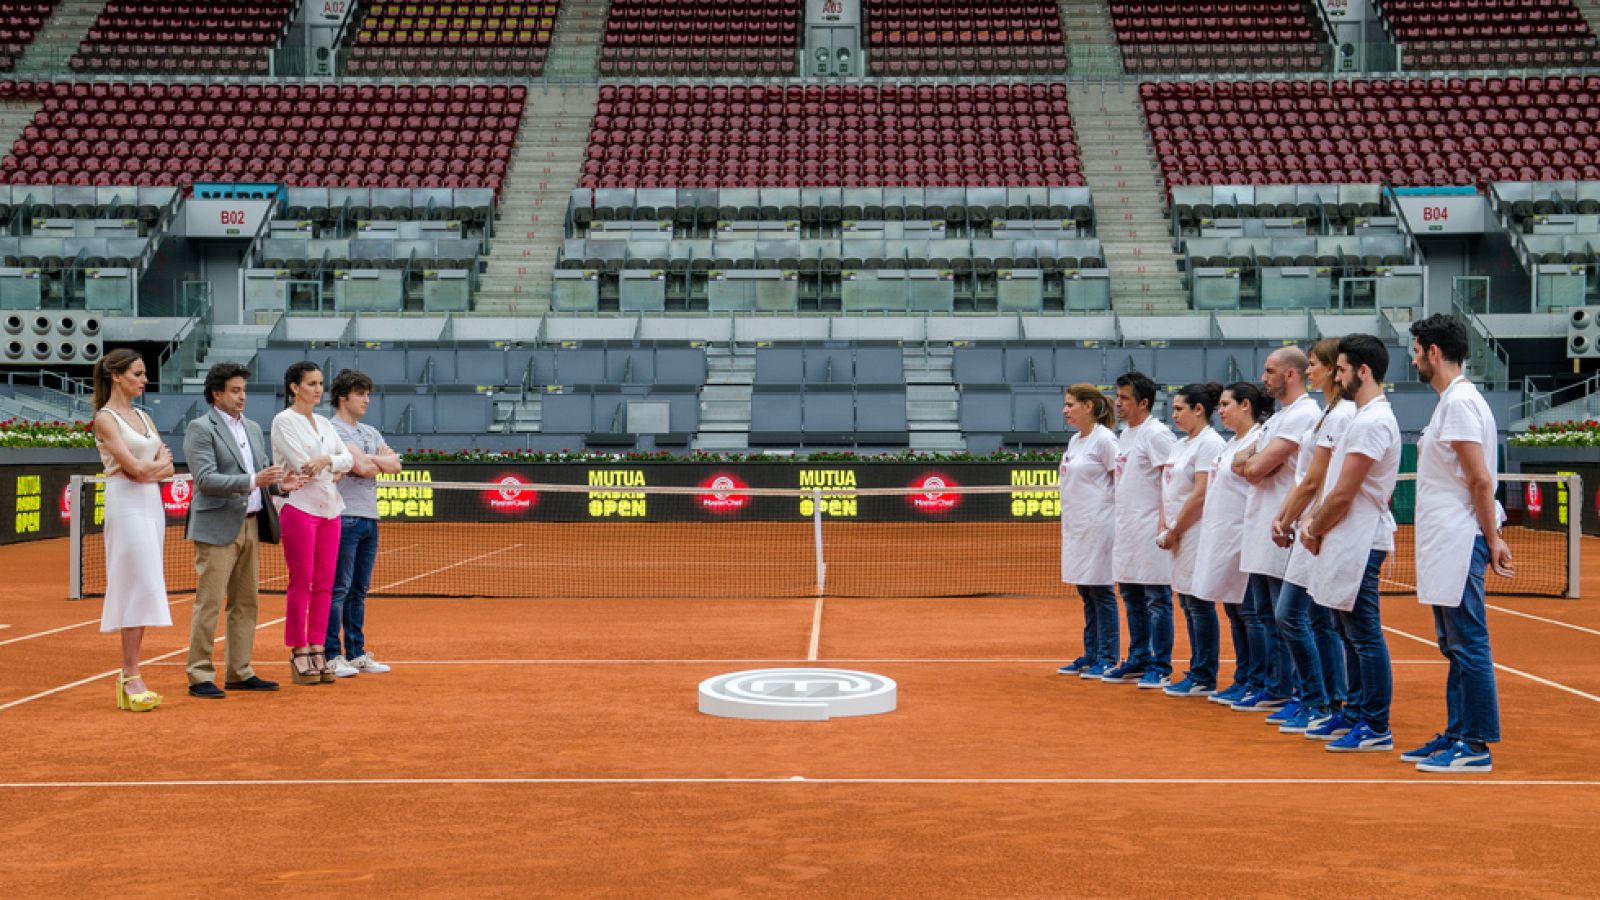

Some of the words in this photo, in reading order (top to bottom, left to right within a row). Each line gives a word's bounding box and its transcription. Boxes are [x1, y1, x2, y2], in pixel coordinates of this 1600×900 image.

[323, 1, 345, 13] A02
[221, 210, 246, 225] B02
[1423, 206, 1448, 221] B04
[588, 470, 646, 486] MUTUA
[799, 470, 857, 486] MUTUA
[1011, 470, 1060, 486] MUTU
[1011, 489, 1061, 499] MADRI
[376, 499, 434, 517] OPEN
[588, 499, 646, 517] OPEN
[799, 499, 858, 517] OPEN
